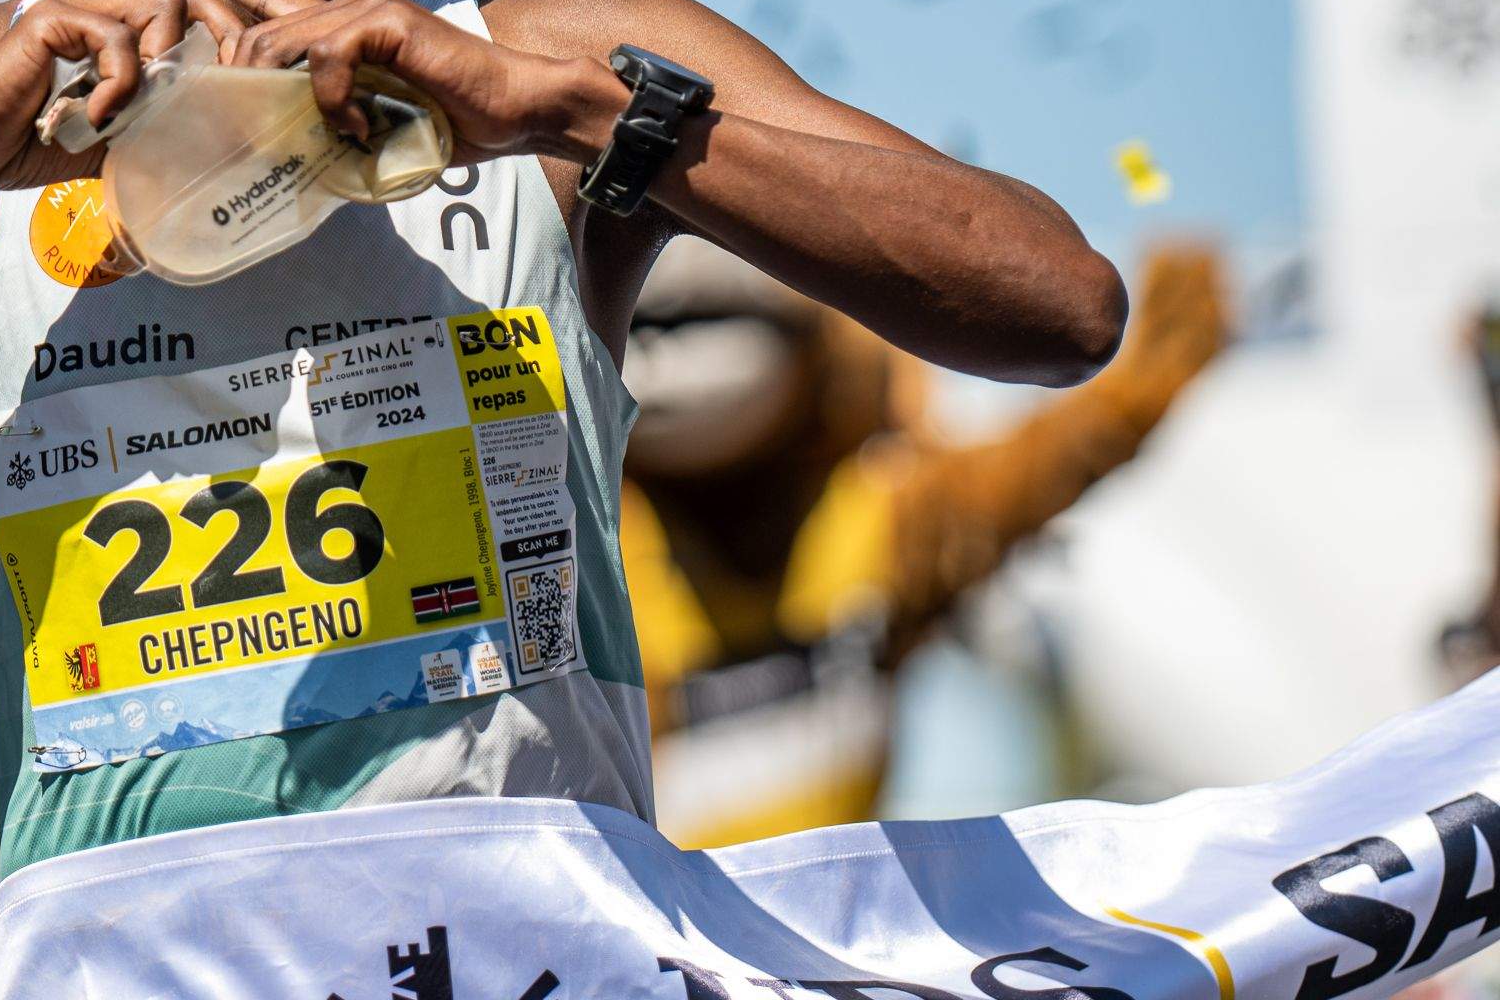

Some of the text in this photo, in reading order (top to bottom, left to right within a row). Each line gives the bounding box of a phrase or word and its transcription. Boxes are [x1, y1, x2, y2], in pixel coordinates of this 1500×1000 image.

[228, 152, 304, 214] HydraPak
[285, 315, 433, 351] CENT
[456, 315, 542, 356] BON
[34, 323, 196, 383] Daudin
[228, 338, 412, 392] SIERRE ZINAL
[325, 375, 334, 383] LA
[466, 360, 541, 387] pour un
[342, 382, 421, 411] ÉDITION
[473, 390, 527, 411] repas
[377, 406, 426, 428] 2024
[126, 413, 271, 456] SALOMON
[39, 439, 99, 477] UBS
[463, 455, 474, 477] Bloc
[485, 471, 516, 486] SIERRE
[529, 465, 560, 479] ZINAL
[503, 517, 516, 525] Your
[83, 460, 385, 627] 226
[517, 536, 559, 553] SCAN ME
[139, 597, 363, 675] CHEPNGENO
